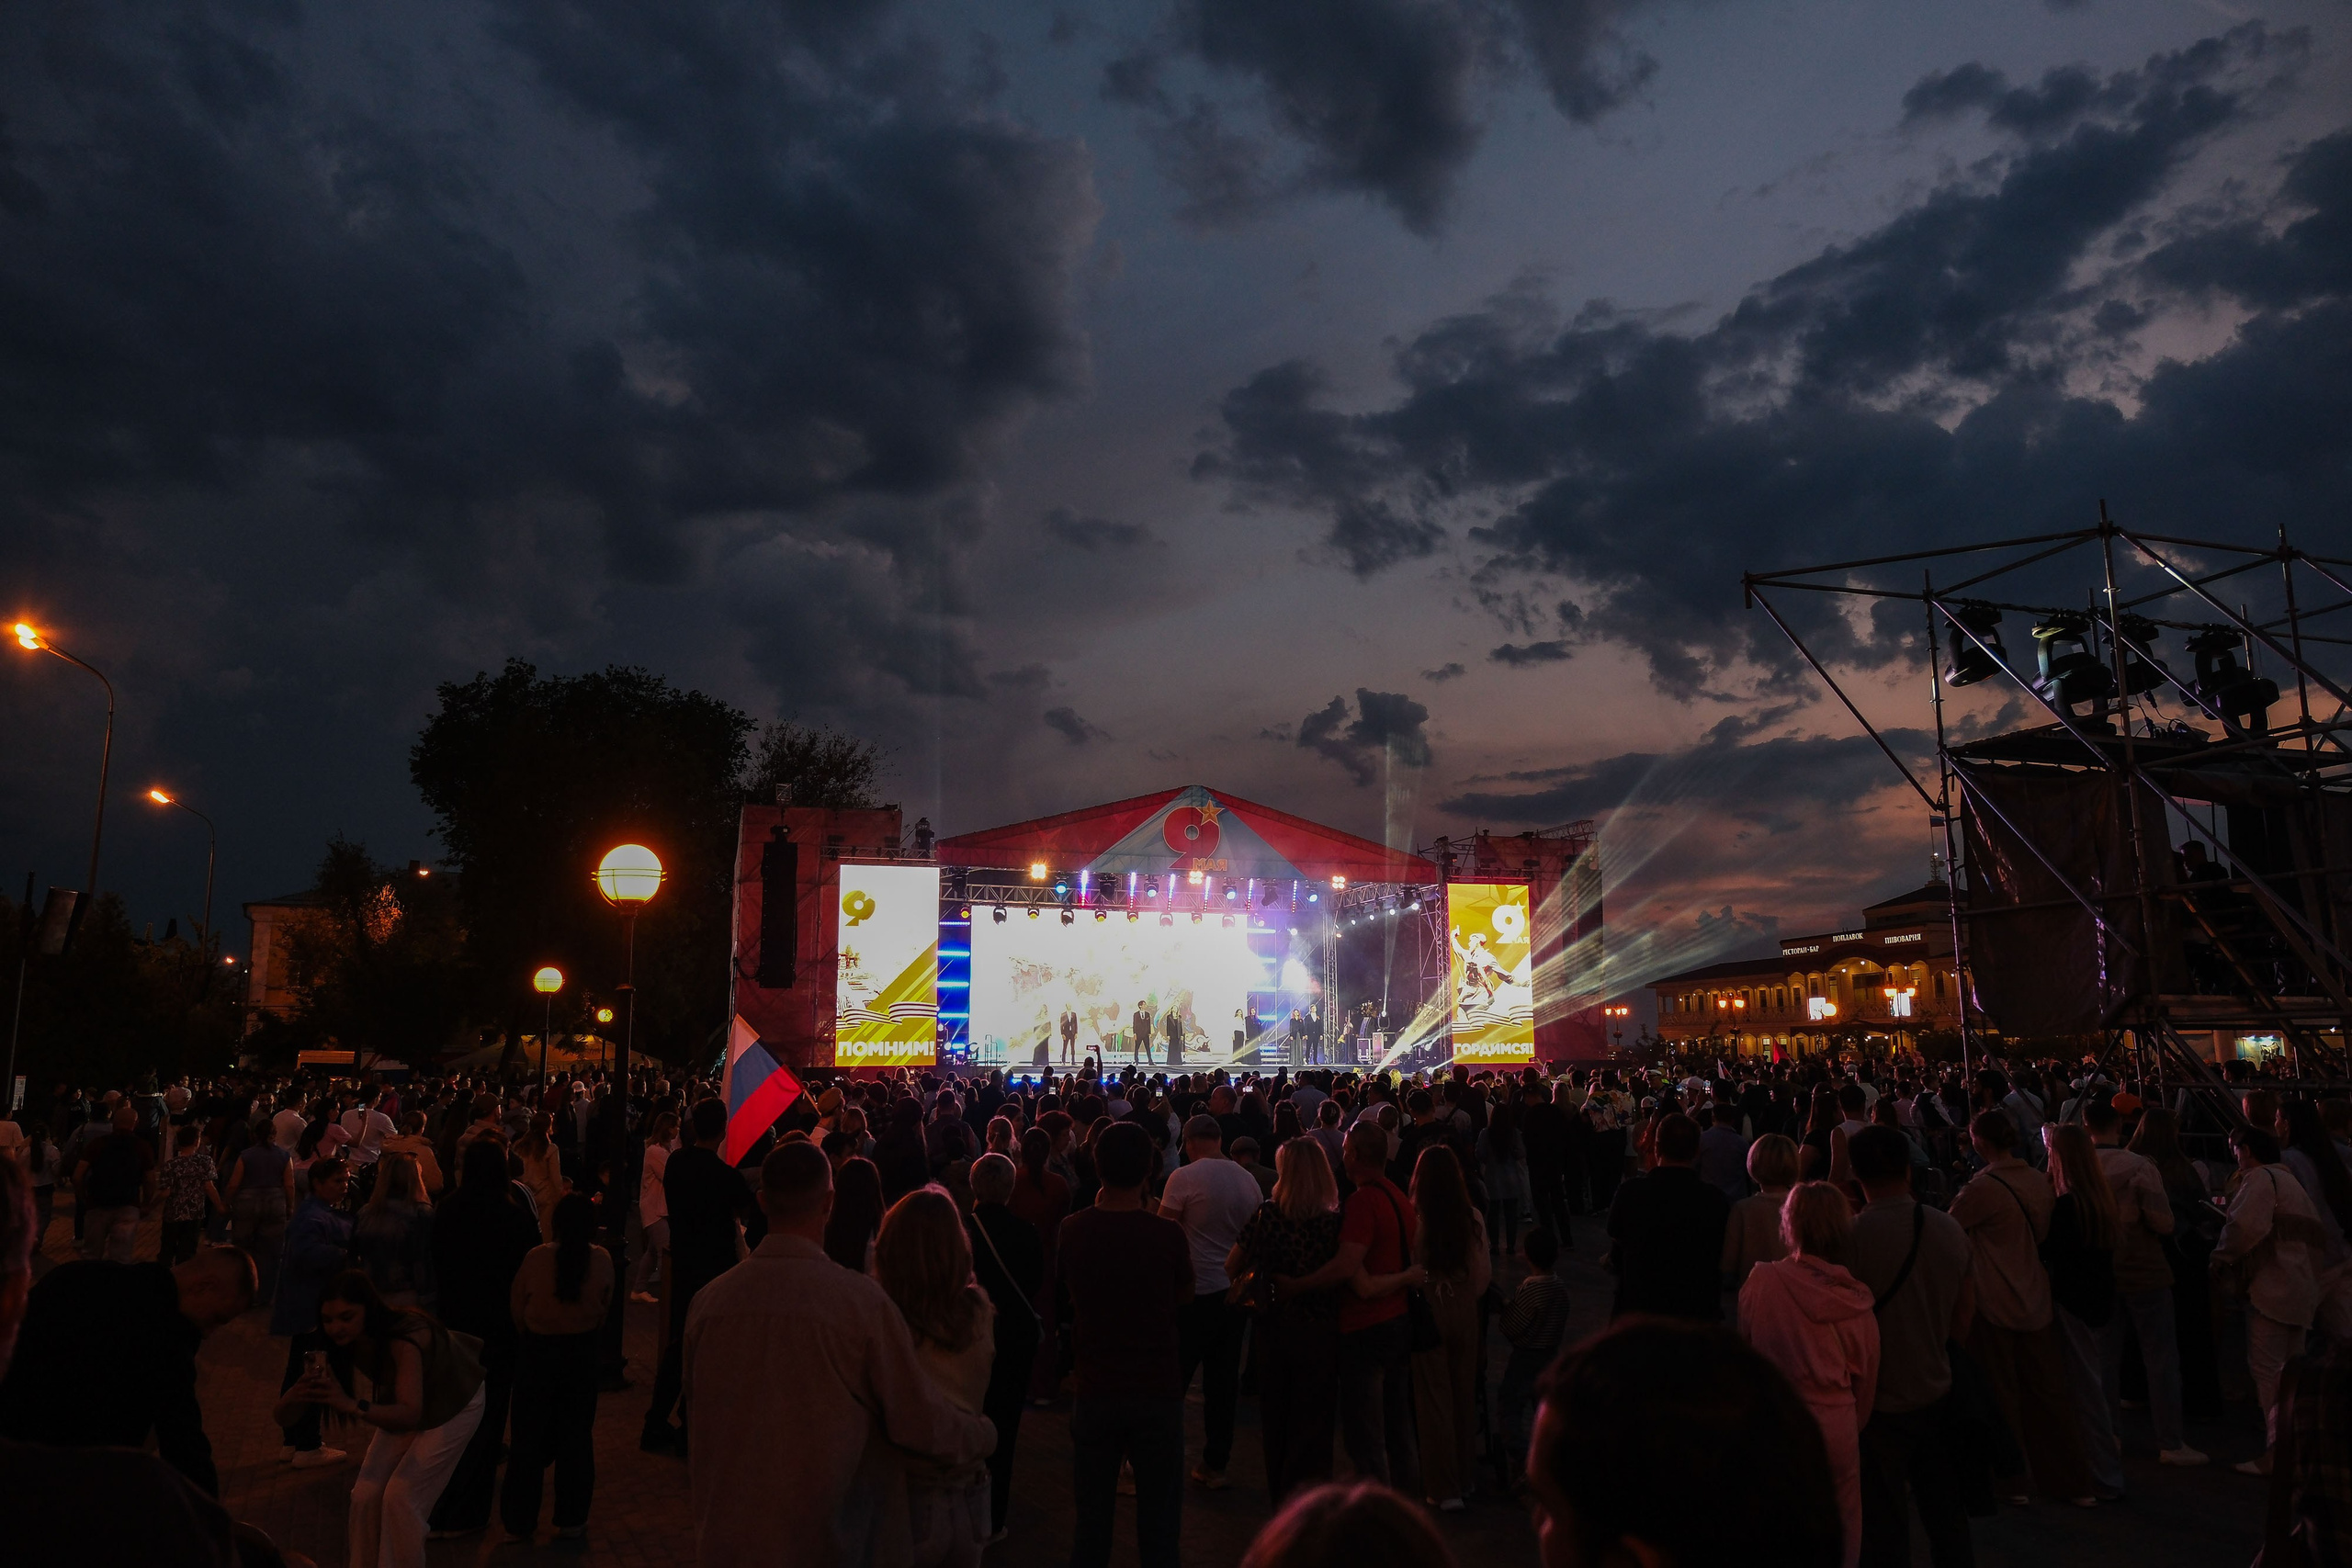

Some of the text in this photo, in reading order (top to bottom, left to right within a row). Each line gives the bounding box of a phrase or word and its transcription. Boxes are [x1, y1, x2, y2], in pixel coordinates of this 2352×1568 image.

[1163, 806, 1228, 872] 9 МАЯ
[842, 890, 876, 927] 9
[1491, 904, 1526, 943] 9
[1833, 932, 1863, 942] ПОПЛАВОК
[1885, 933, 1921, 943] ПИВОВАРНЯ
[837, 1041, 935, 1057] ПОМНИМ!
[1453, 1043, 1534, 1057] ГОРДИМСЯ!
